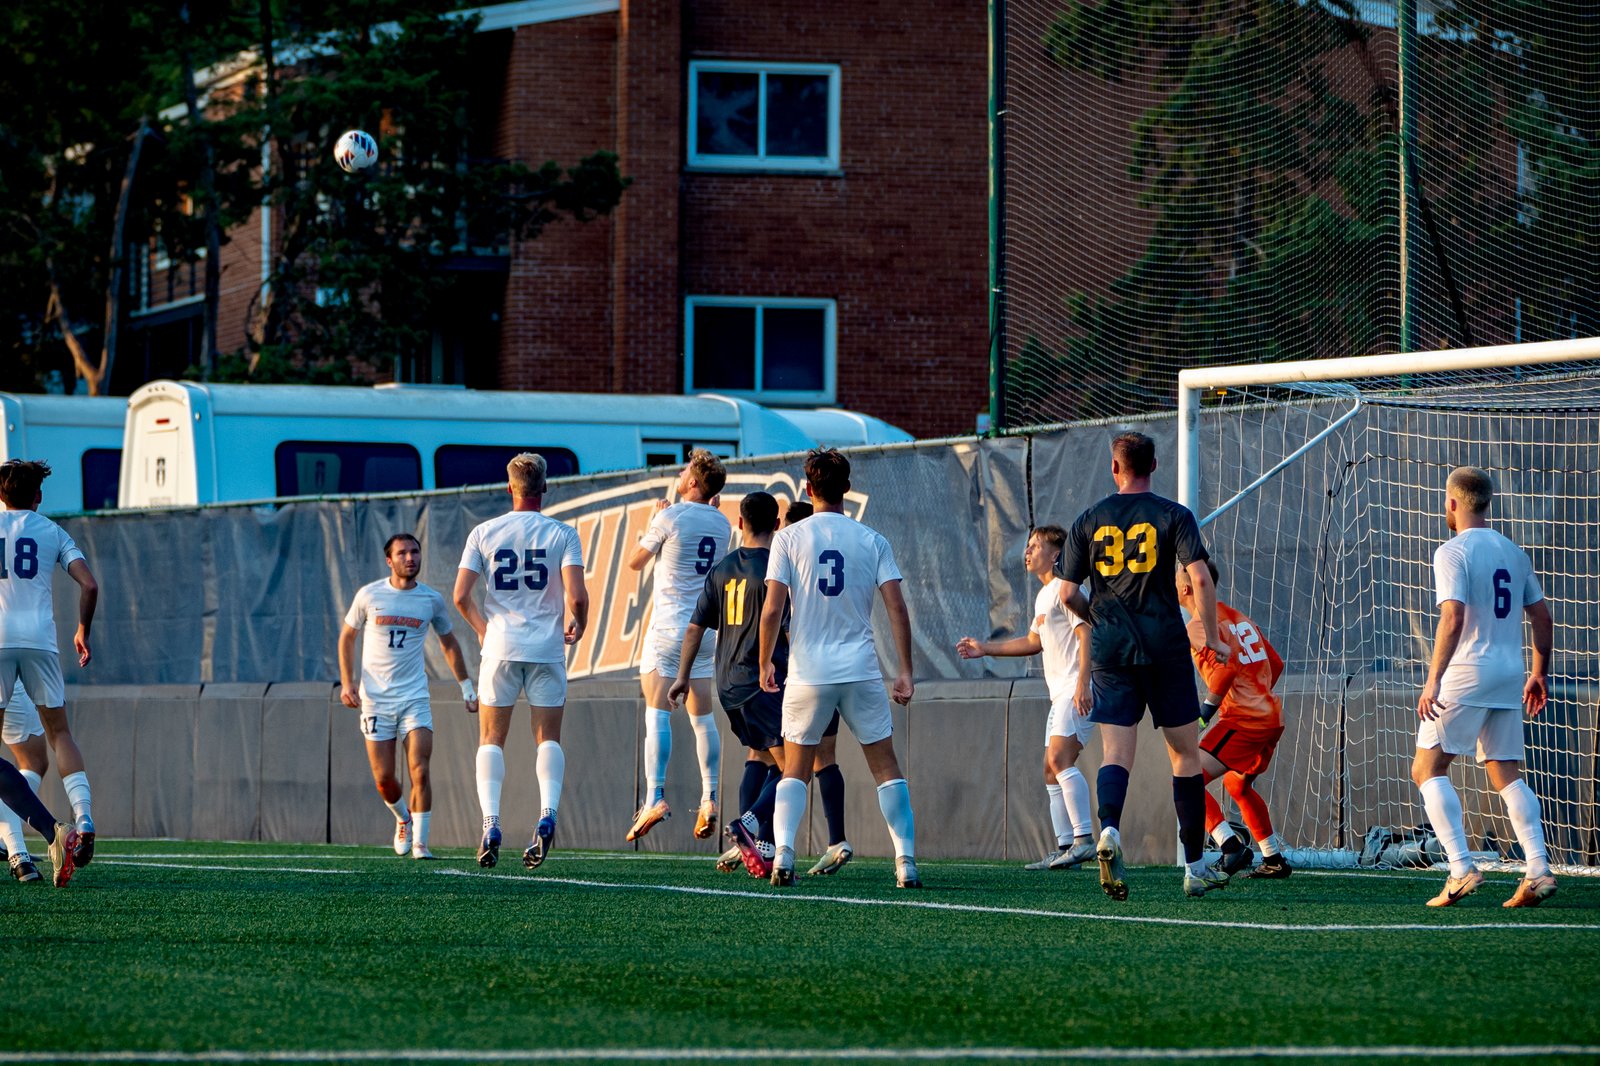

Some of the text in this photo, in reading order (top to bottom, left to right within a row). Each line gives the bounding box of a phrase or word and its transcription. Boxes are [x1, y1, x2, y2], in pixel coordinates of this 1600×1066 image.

[0, 537, 39, 580] 18
[494, 549, 549, 591] 25
[695, 537, 716, 575] 9
[1093, 522, 1157, 577] 33
[818, 550, 845, 597] 3
[1493, 568, 1512, 619] 6
[725, 578, 747, 626] 11
[388, 630, 407, 648] 17
[363, 715, 378, 735] 17
